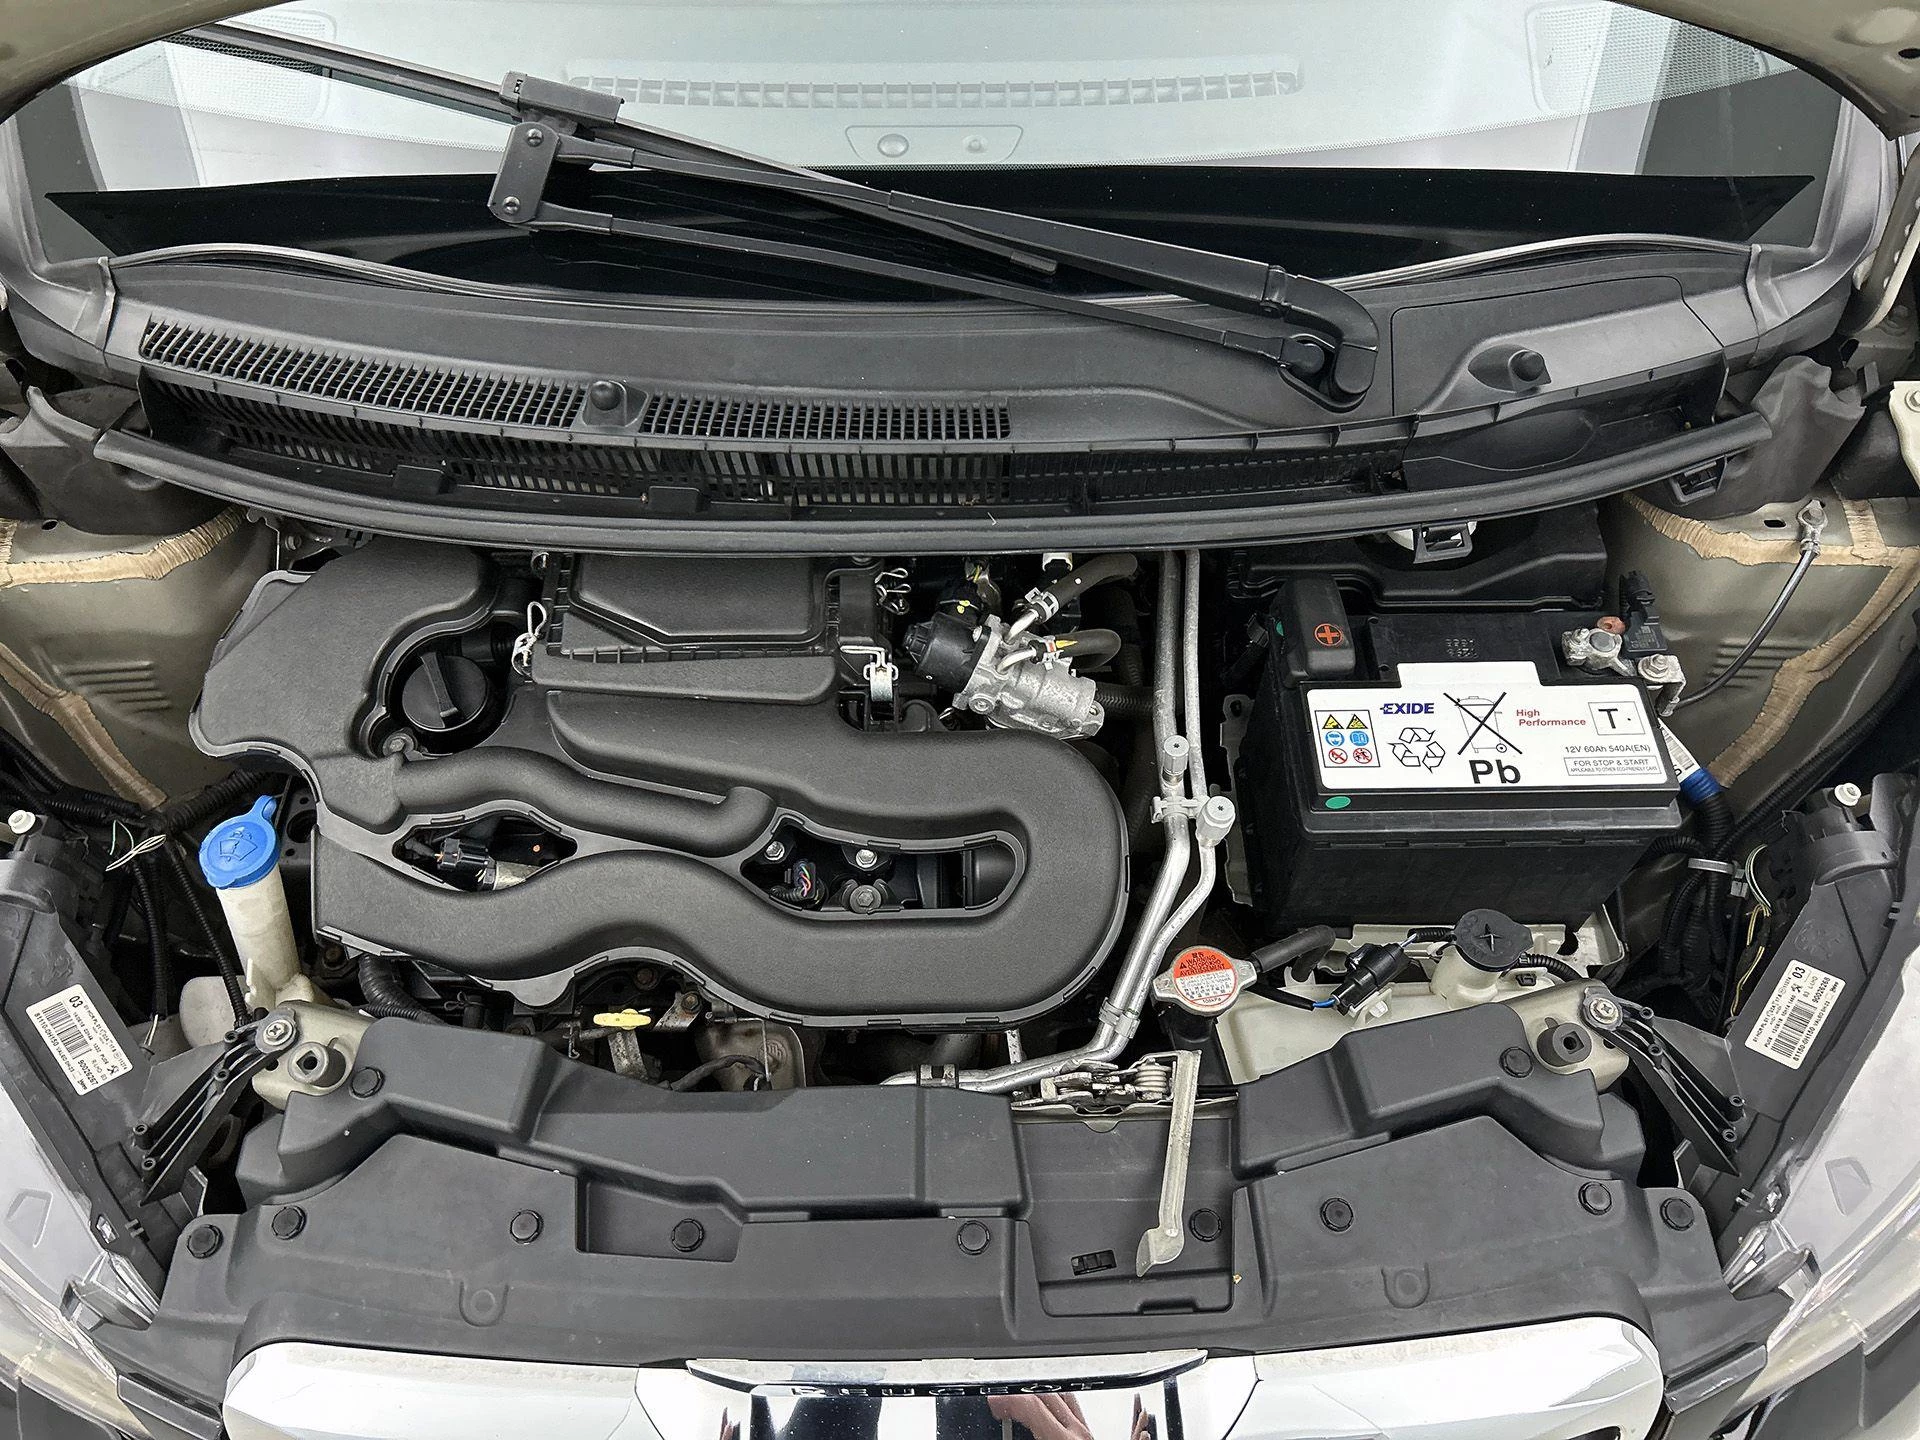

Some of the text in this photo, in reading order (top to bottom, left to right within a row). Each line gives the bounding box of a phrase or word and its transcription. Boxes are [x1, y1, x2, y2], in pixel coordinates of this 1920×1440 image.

[1380, 703, 1434, 714] EXIDE
[1516, 709, 1540, 718] High
[1598, 708, 1618, 729] T
[1469, 759, 1521, 784] Pb
[1792, 967, 1805, 978] 03
[69, 996, 83, 1008] 03
[790, 1382, 1104, 1397] PEUGEOT
